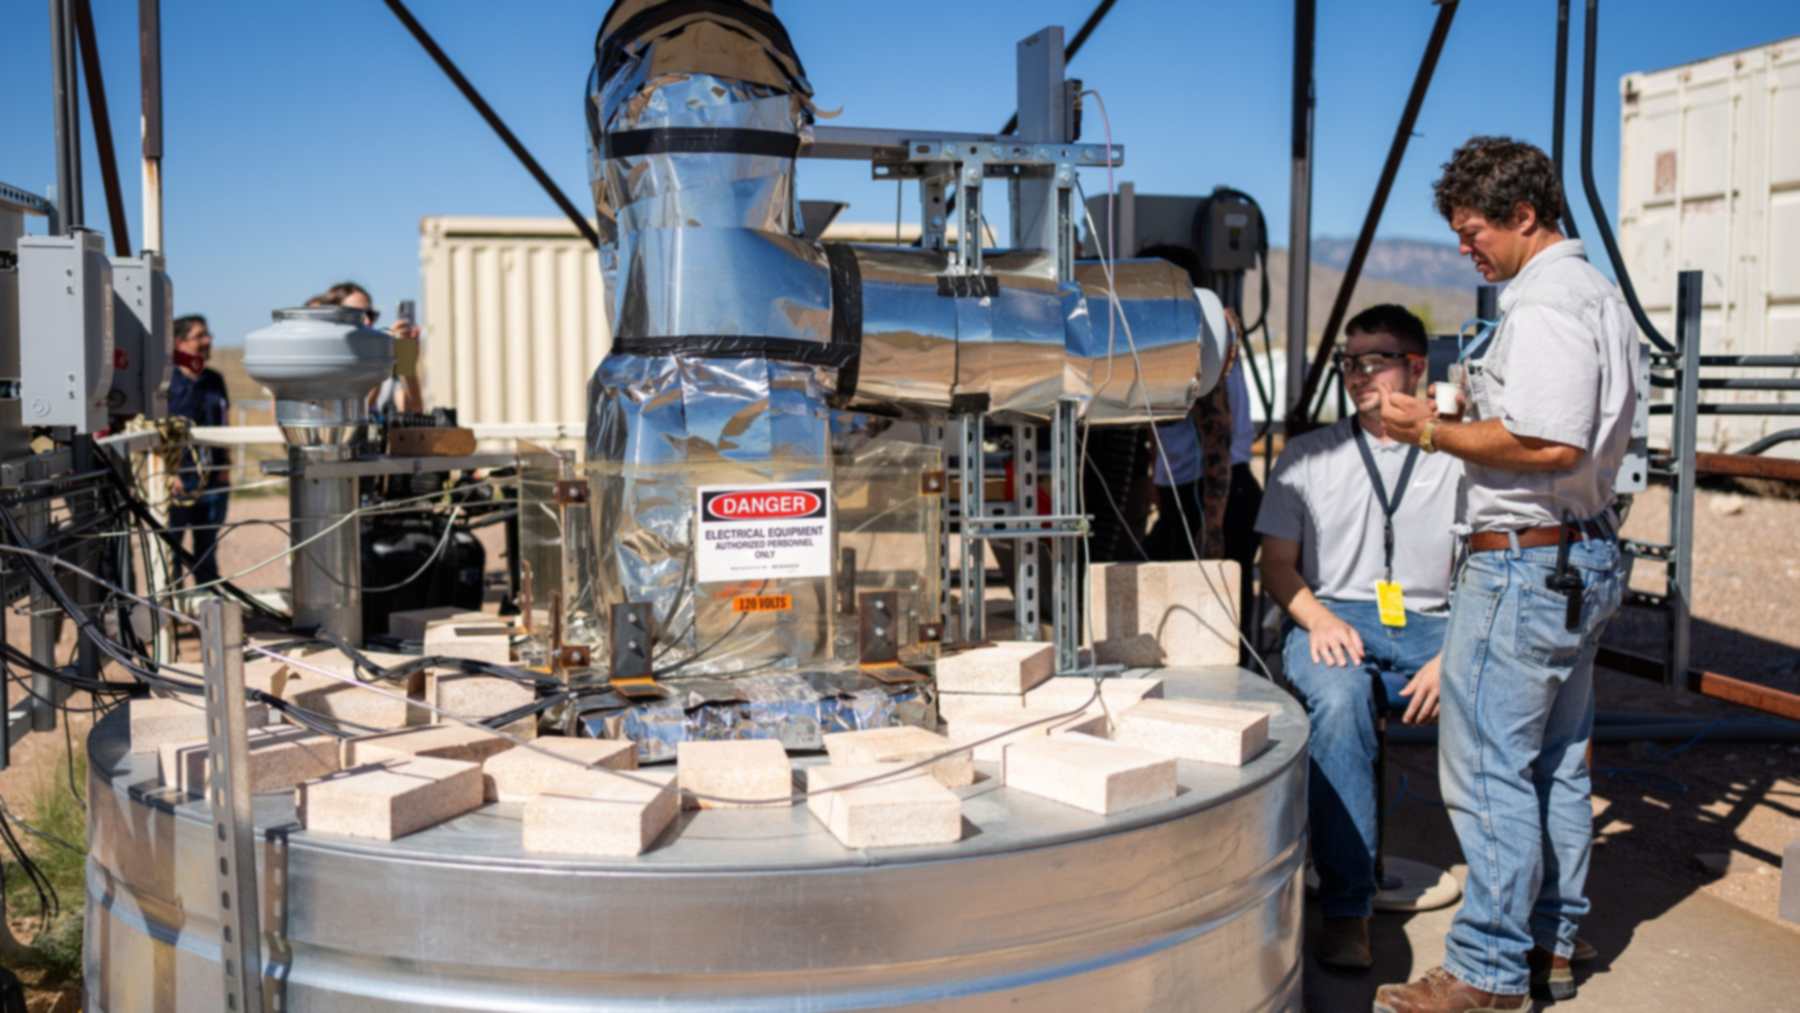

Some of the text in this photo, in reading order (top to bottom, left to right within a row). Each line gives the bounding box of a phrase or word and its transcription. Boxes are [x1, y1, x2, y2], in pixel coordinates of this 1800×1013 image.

[723, 496, 806, 514] DANGER
[705, 526, 823, 541] ELECTRICAL EQUIPMENT
[715, 538, 814, 550] AUTHORIZED PERSONNEL
[754, 550, 776, 559] ONLY
[739, 596, 786, 610] 120 VOLTS
